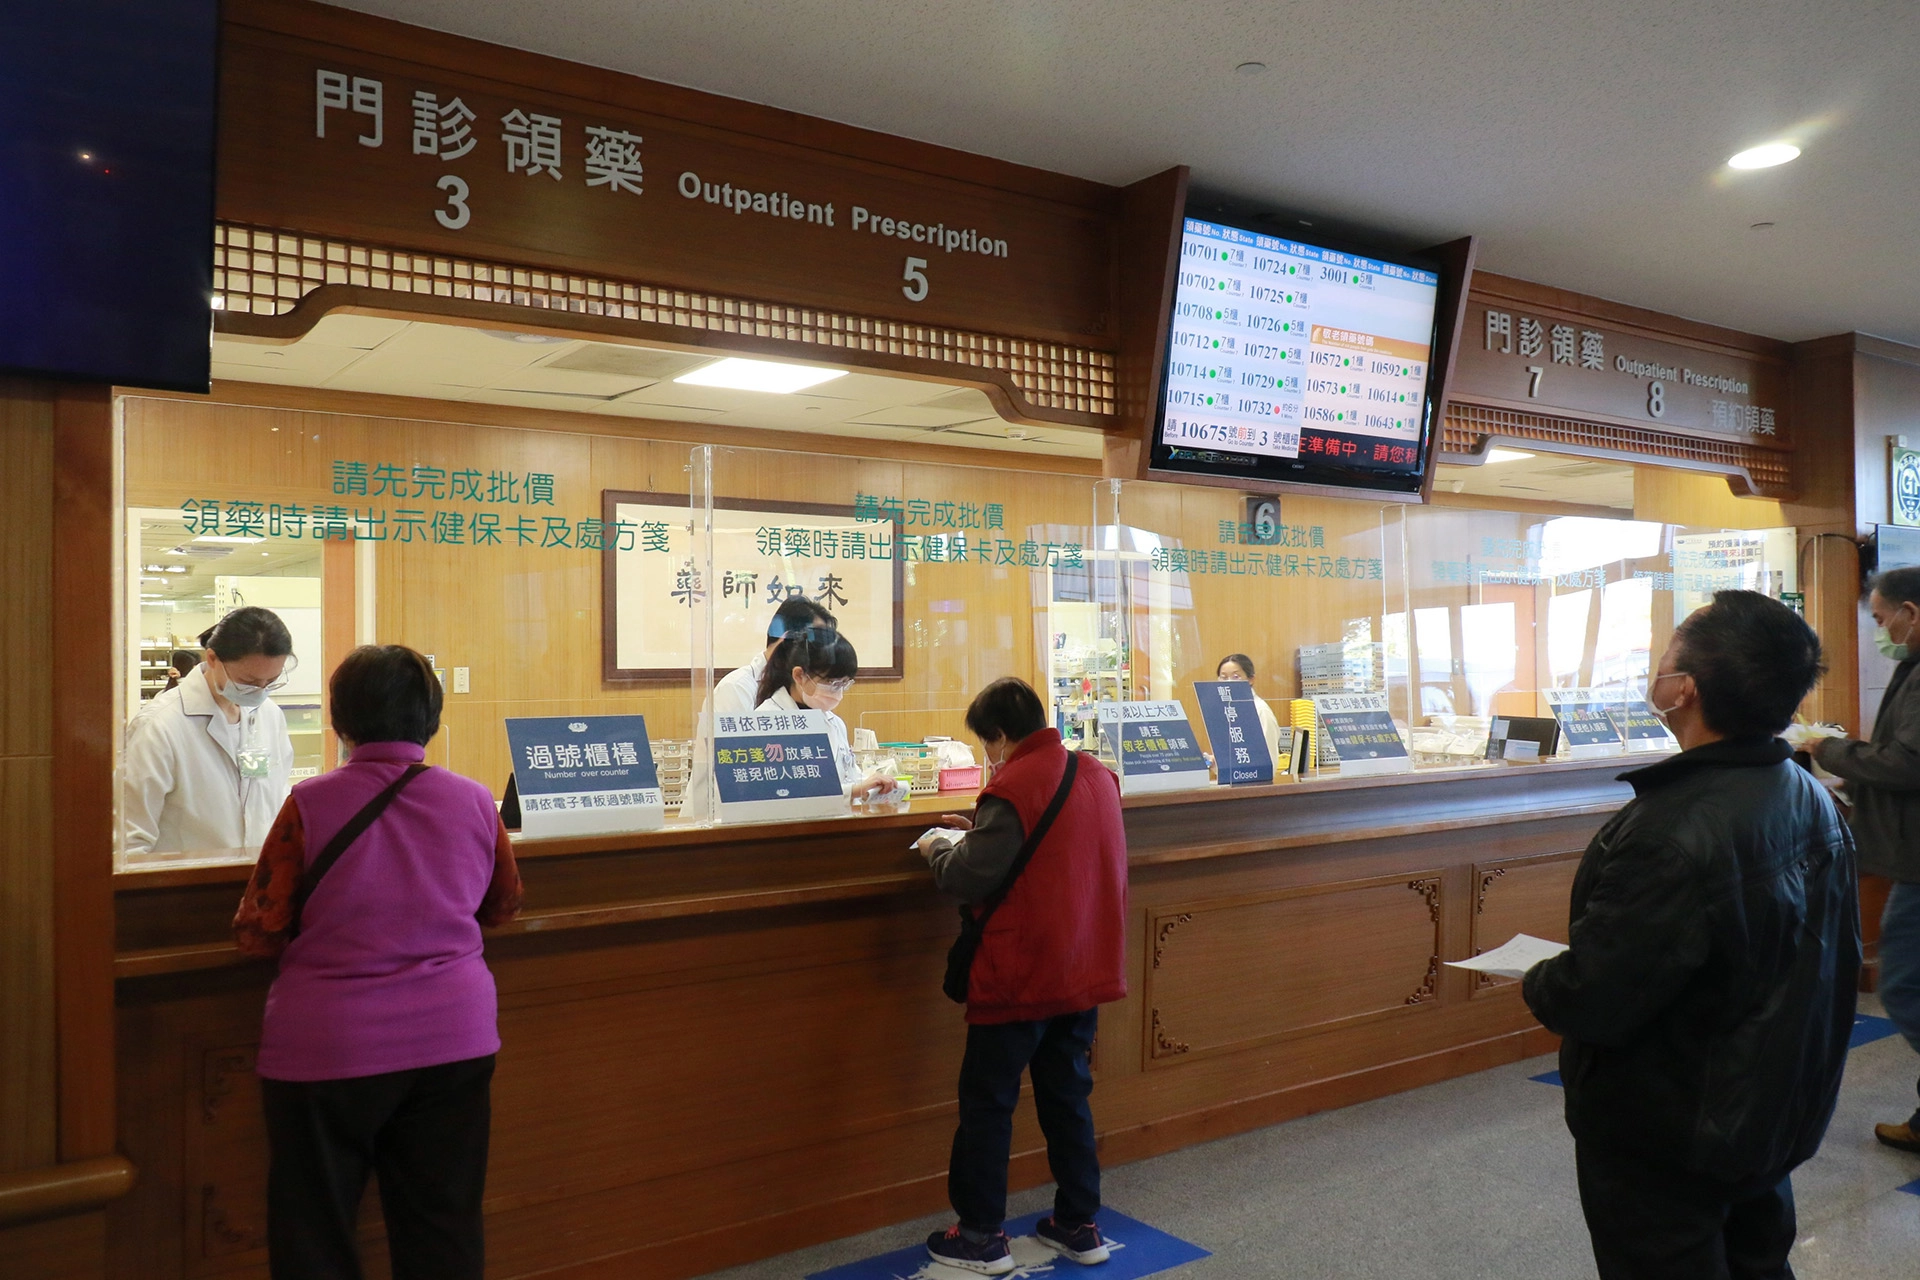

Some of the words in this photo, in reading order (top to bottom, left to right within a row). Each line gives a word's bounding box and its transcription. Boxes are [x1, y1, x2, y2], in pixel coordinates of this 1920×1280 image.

[316, 68, 644, 196] 門診領藥
[678, 171, 835, 227] Outpatient
[851, 206, 1008, 258] Prescription
[434, 175, 471, 230] 3
[1182, 242, 1217, 261] 10701
[1253, 256, 1286, 275] 10724
[902, 256, 929, 302] 5
[1180, 272, 1215, 291] 10702
[1320, 267, 1348, 284] 3001
[1250, 285, 1284, 304] 10725
[1176, 301, 1212, 320] 10708
[1246, 314, 1280, 332] 10726
[1174, 331, 1209, 349] 10712
[1244, 343, 1278, 360] 10727
[1310, 351, 1341, 367] 10572
[1486, 310, 1604, 371] 門診領藥
[1614, 354, 1678, 383] Outpatient
[1683, 367, 1748, 395] Prescription
[1171, 361, 1206, 379] 10714
[1371, 361, 1400, 376] 10592
[1241, 372, 1275, 389] 10729
[1307, 379, 1338, 395] 10573
[1526, 366, 1543, 398] 7
[1167, 389, 1204, 406] 10715
[1367, 387, 1397, 403] 10614
[1648, 381, 1665, 418] 8
[1238, 399, 1271, 416] 10732
[1303, 406, 1335, 422] 10586
[1364, 414, 1394, 430] 10643
[1711, 400, 1776, 435] 預約領藥
[1181, 421, 1227, 442] 10675
[1258, 431, 1268, 446] 3
[331, 459, 555, 507] 請先完成批價
[854, 494, 1005, 531] 請先完成批價
[1255, 502, 1275, 541] 6
[180, 498, 671, 554] 領藥時請出示健保卡及處方箋
[755, 525, 1084, 570] 領藥時請出示健保卡及處方箋
[1150, 547, 1384, 581] 領藥時請出示健保卡及處方箋
[671, 568, 849, 610] 藥師如來
[719, 714, 809, 733] 請依序排隊
[1138, 725, 1162, 738] 請至
[1217, 685, 1250, 764] 暫停服務
[525, 742, 639, 771] 過號櫃檯
[717, 743, 828, 764] 處方箋勿放桌上
[544, 770, 577, 779] Number
[581, 770, 599, 778] over
[600, 768, 630, 777] counter
[733, 764, 822, 783] 避免他人誤取
[1233, 769, 1258, 780] Closed
[525, 791, 658, 811] 請依電子看板過號顯示
